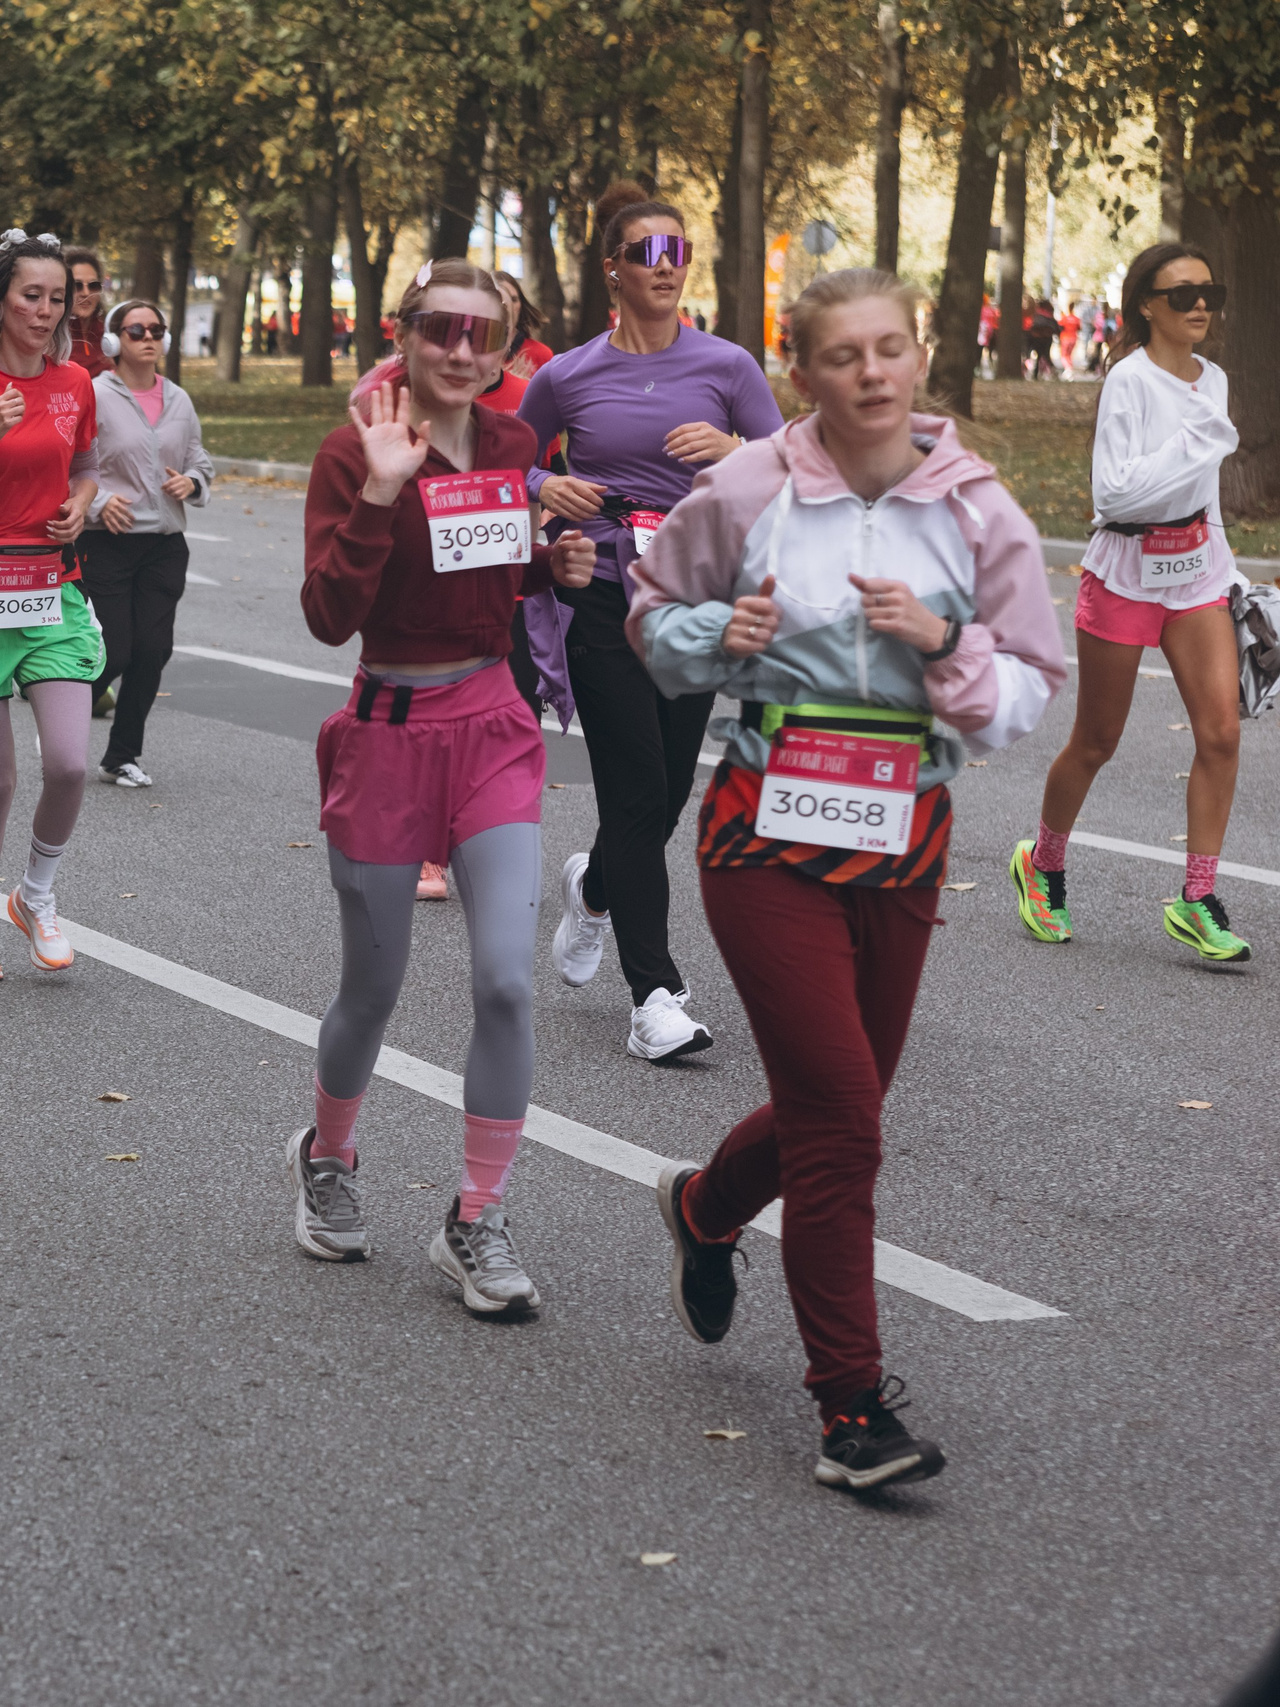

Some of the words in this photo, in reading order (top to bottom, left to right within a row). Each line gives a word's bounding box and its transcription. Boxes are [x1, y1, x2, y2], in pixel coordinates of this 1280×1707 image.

[438, 522, 518, 550] 30990
[1151, 554, 1203, 575] 31035
[771, 789, 885, 827] 30658
[898, 804, 910, 842] МОСКВА
[856, 836, 865, 847] 3
